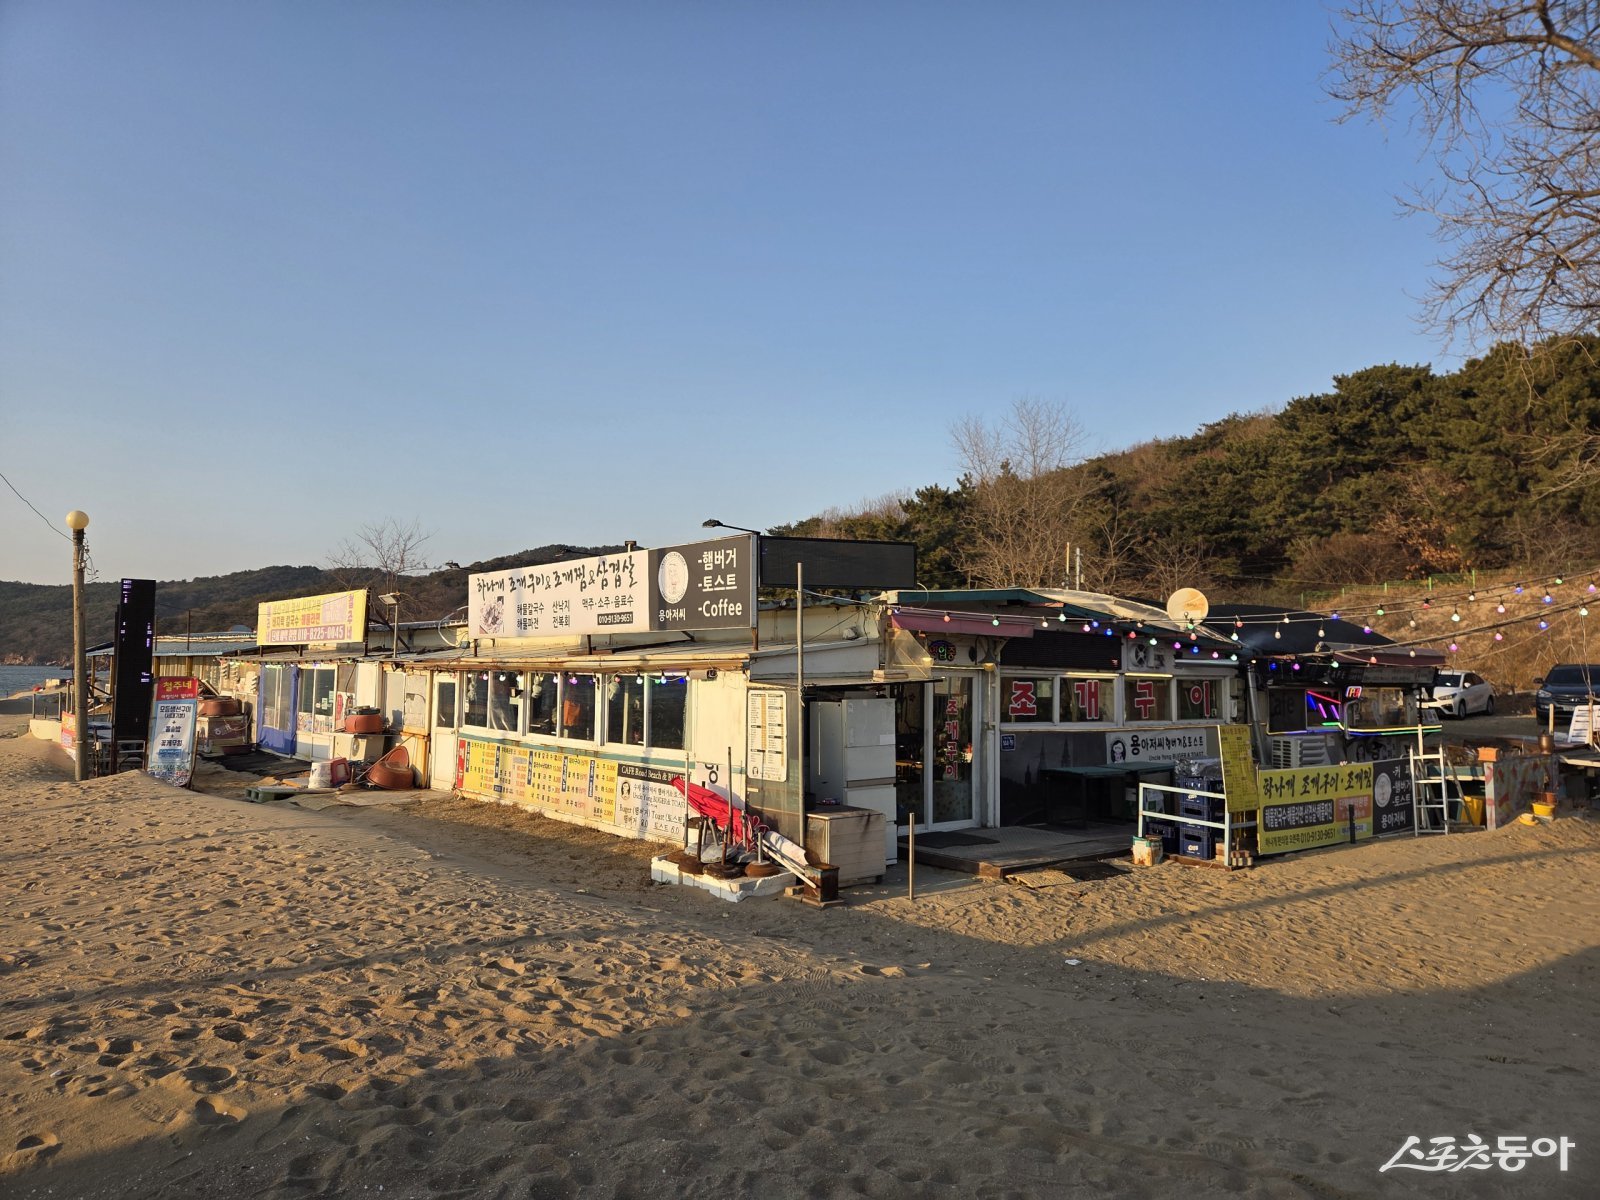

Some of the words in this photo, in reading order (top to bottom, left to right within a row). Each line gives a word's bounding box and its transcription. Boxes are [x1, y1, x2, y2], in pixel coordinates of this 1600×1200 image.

[476, 577, 505, 601] 하나개
[698, 573, 738, 592] -토스트
[517, 602, 545, 616] 해물칼국수
[552, 599, 570, 613] 산낙지
[517, 617, 539, 631] 해물파전
[552, 615, 571, 629] 전복회
[598, 612, 633, 624] 010-9130-9651
[163, 680, 192, 692] 철주네
[946, 699, 959, 781] 조개구이
[621, 766, 635, 775] CAFE
[648, 769, 661, 780] Beach
[1263, 775, 1296, 799] 하나개
[1380, 811, 1407, 829] 용아저씨
